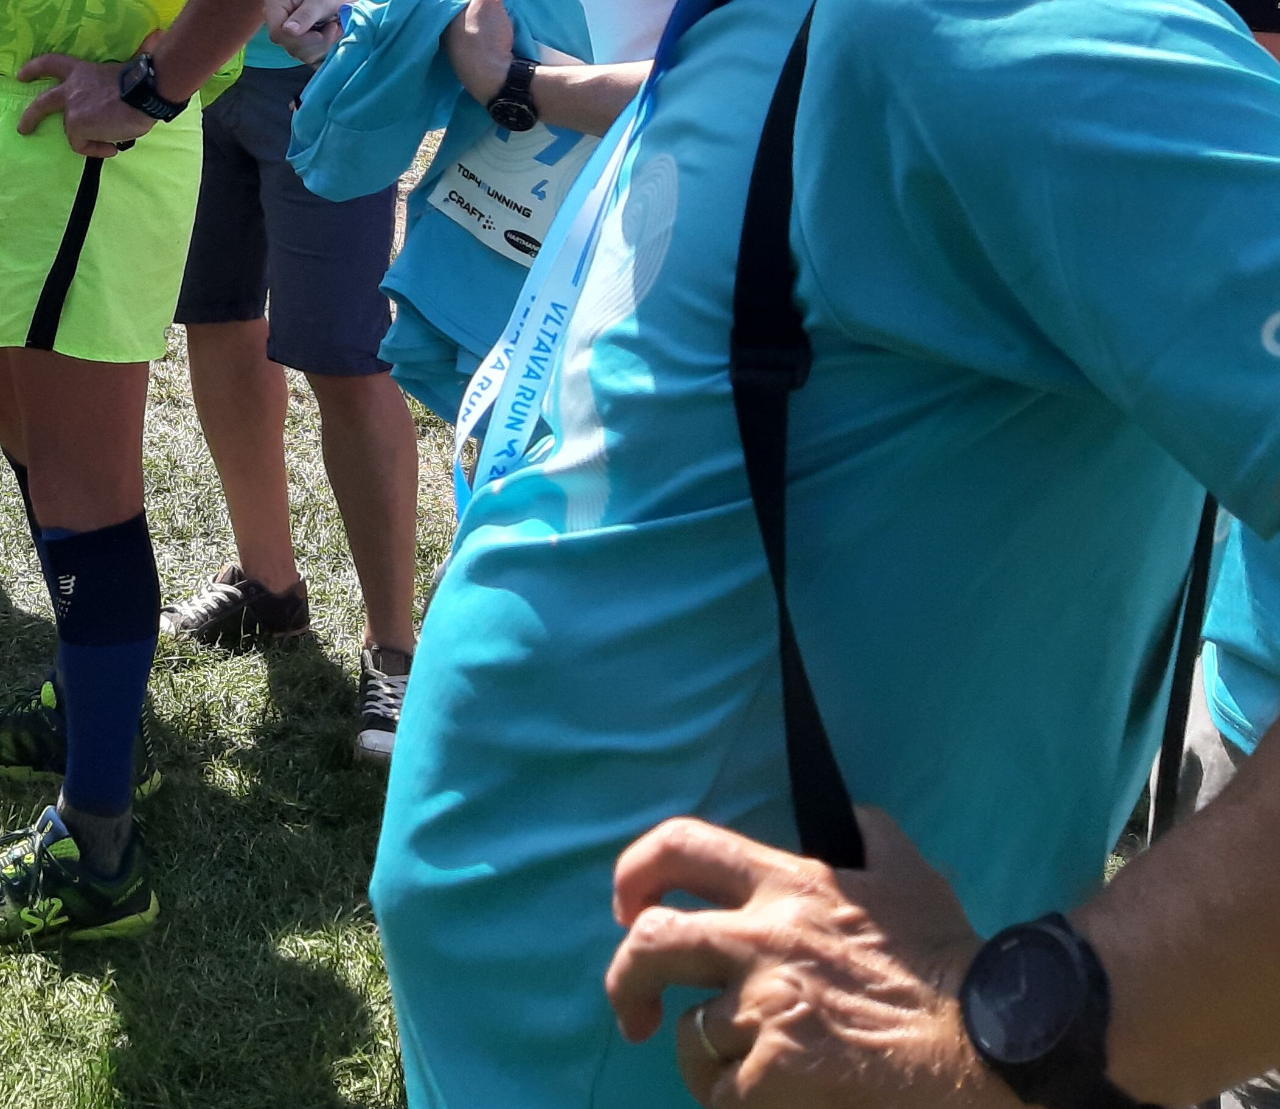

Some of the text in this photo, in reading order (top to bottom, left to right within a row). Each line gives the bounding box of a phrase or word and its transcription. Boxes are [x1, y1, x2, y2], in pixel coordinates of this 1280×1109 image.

[448, 189, 485, 223] CRAFT
[456, 162, 533, 220] TOP4RUNNING
[508, 301, 568, 434] VLTAVA RUN
[460, 378, 493, 426] RUN
